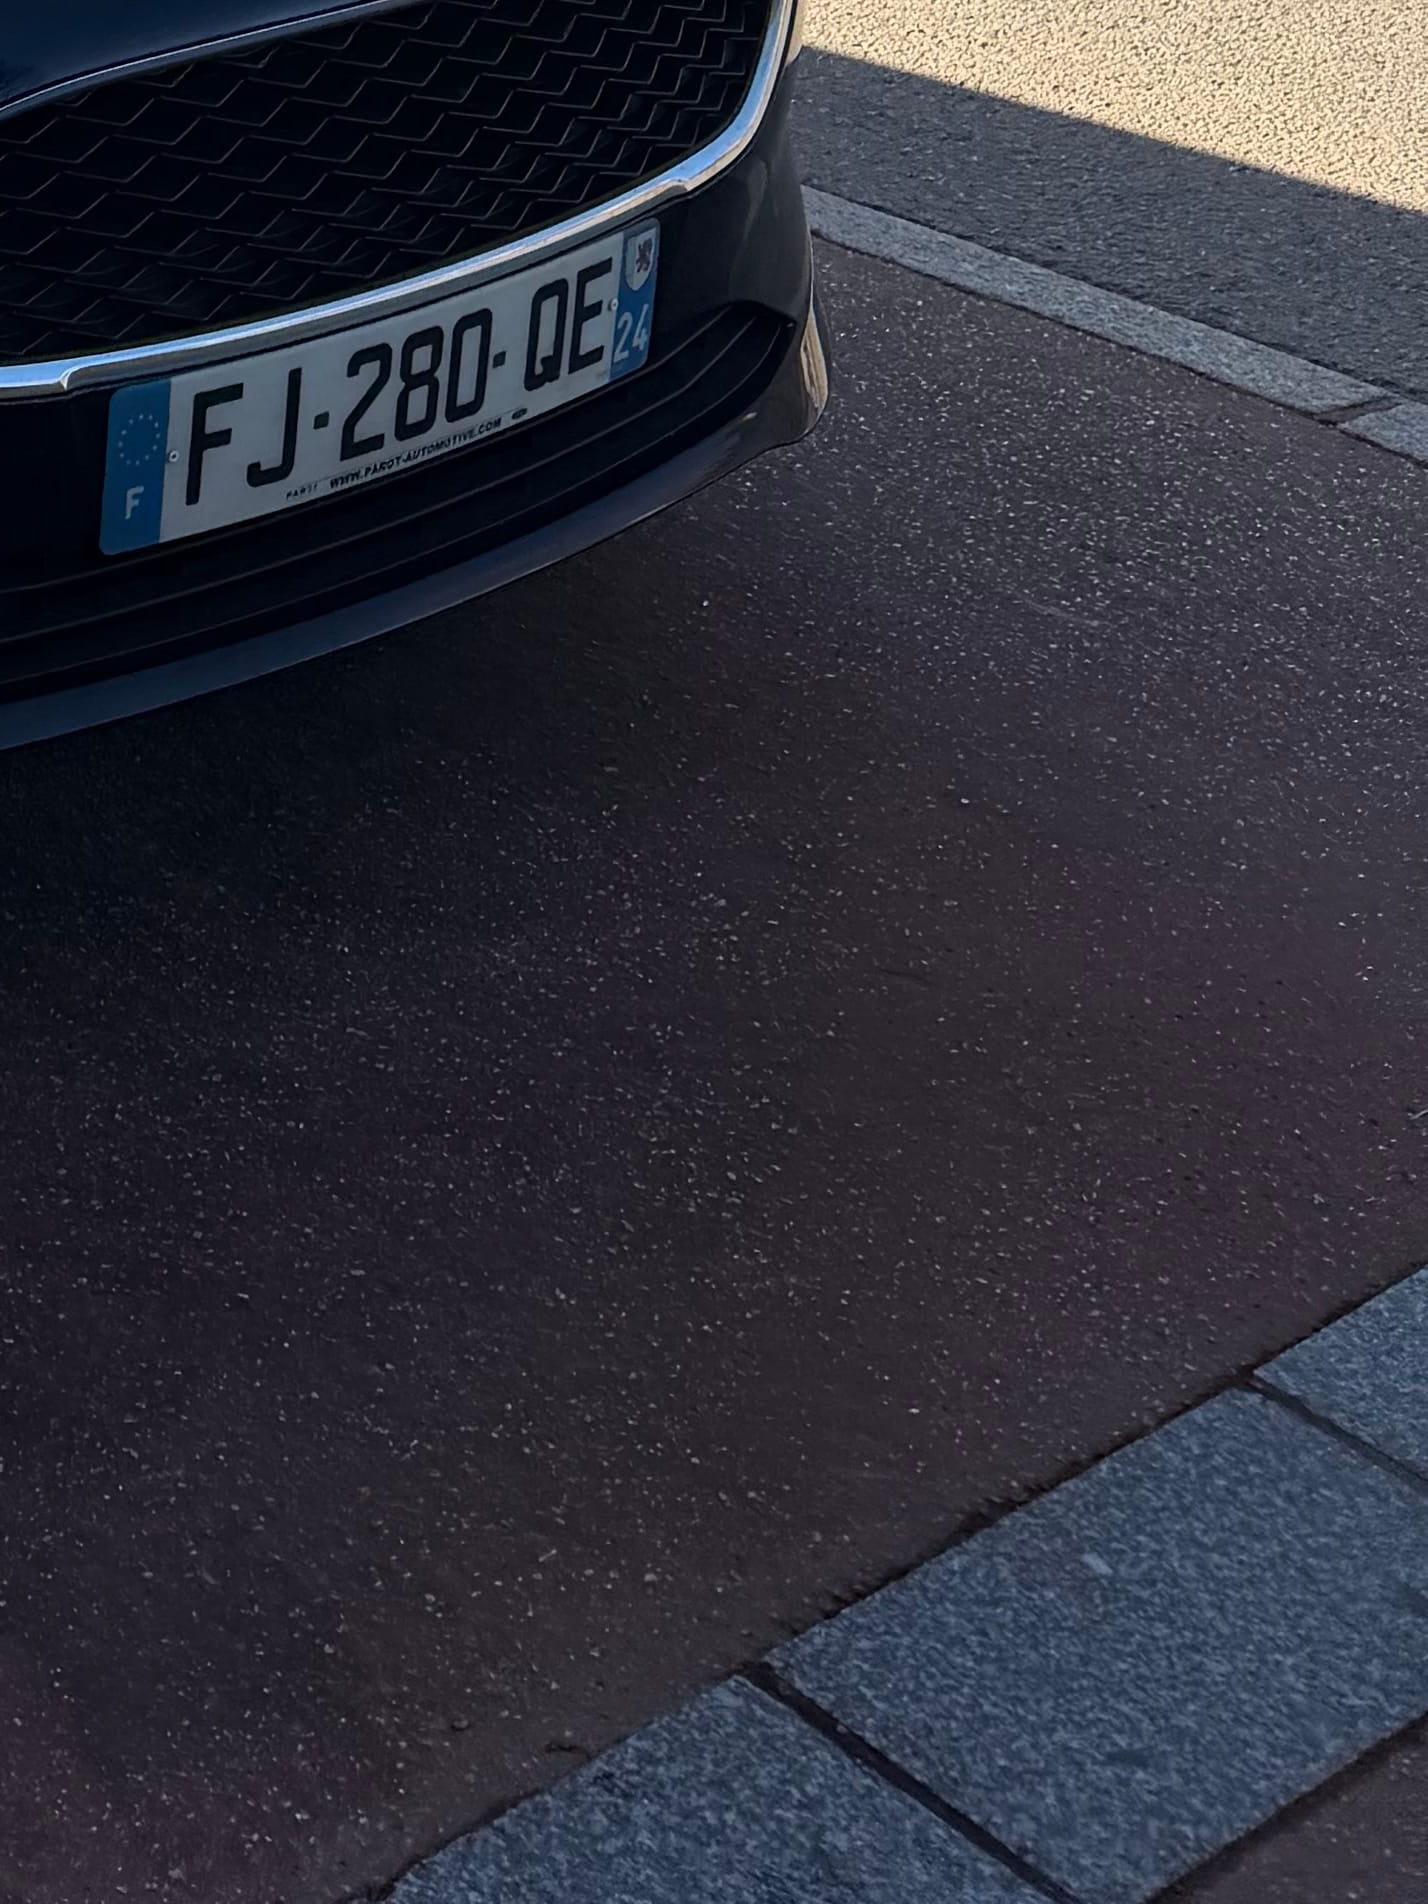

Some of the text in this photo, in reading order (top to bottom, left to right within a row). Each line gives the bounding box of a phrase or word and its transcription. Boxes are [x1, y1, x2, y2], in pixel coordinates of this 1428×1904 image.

[123, 257, 650, 520] F FJ-280-QE 24
